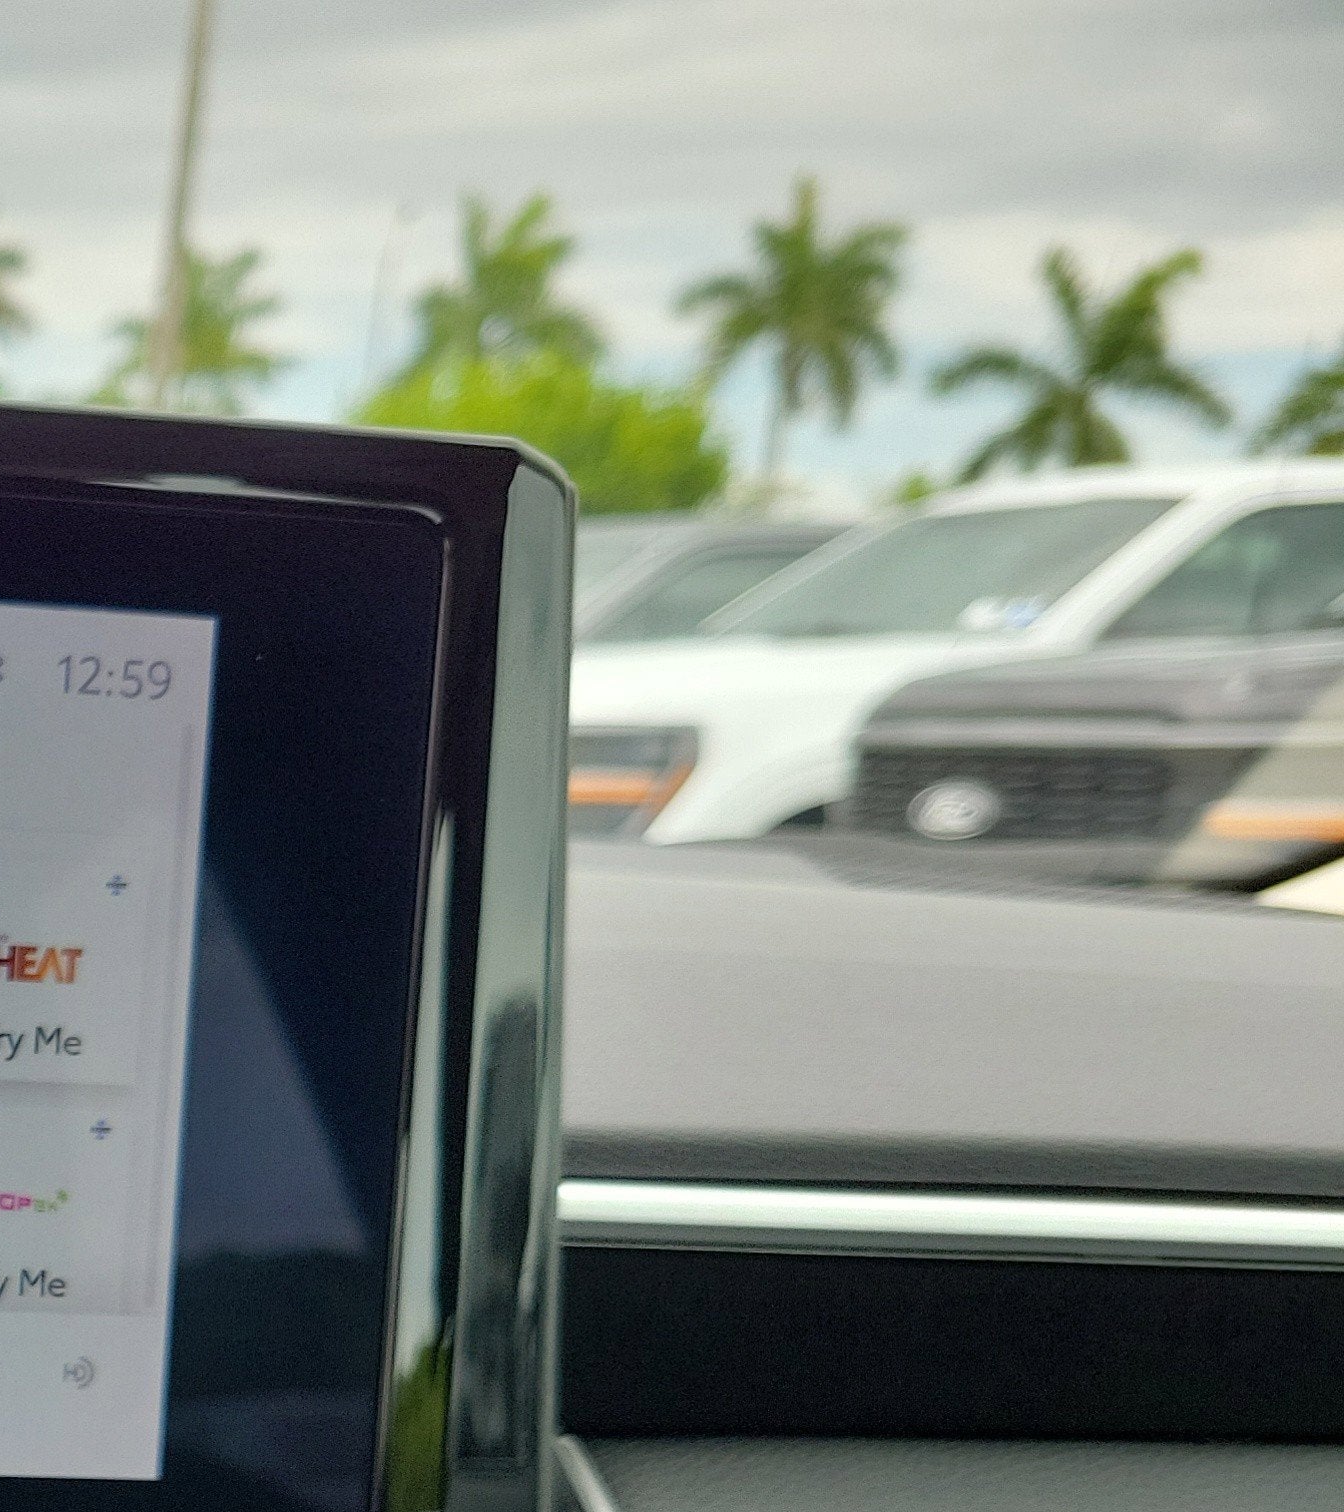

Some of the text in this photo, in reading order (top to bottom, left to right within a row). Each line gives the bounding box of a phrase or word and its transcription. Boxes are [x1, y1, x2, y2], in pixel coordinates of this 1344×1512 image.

[57, 654, 173, 701] 12:59
[34, 1026, 83, 1057] Me
[18, 1269, 67, 1299] Me
